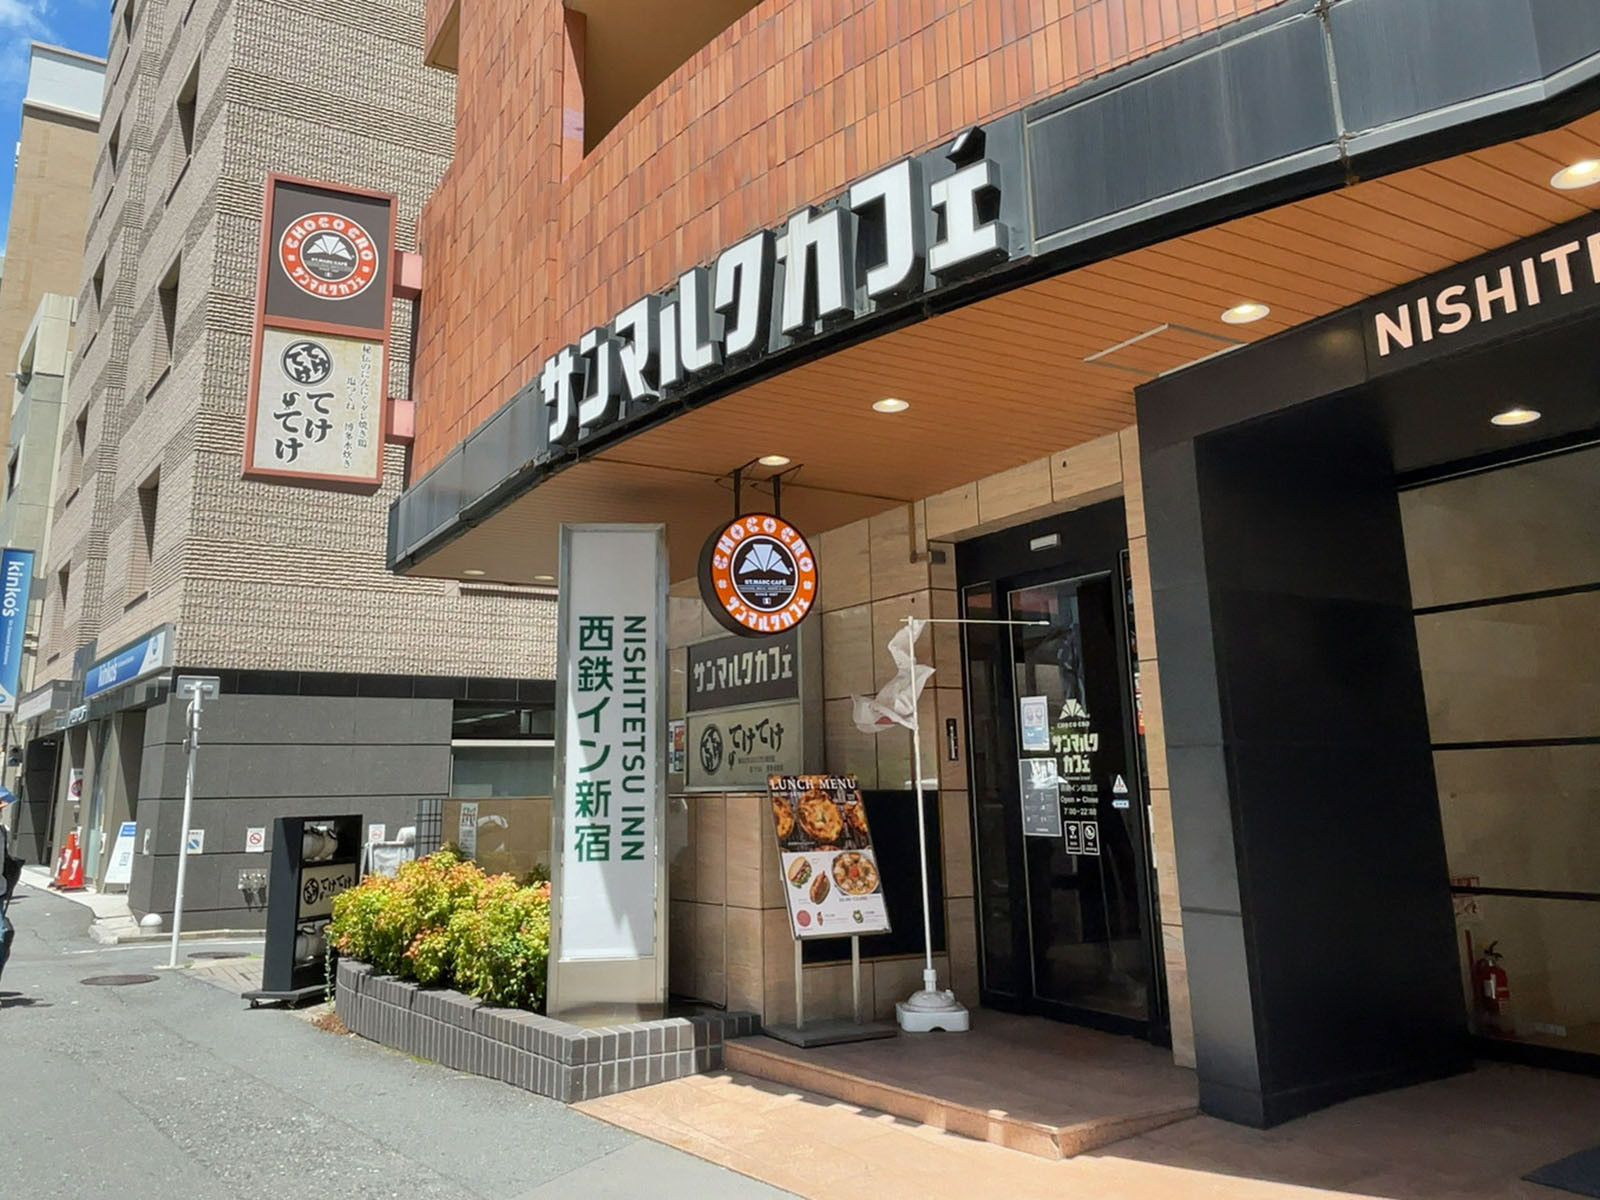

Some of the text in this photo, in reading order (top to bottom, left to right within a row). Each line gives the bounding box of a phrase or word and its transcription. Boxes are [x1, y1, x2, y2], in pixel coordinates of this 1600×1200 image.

[285, 216, 374, 261] CHOCO CRO
[292, 266, 367, 296] サンマルクカフェ
[541, 127, 1006, 444] サンマルクカフェ
[713, 517, 814, 573] CHOCO CRO
[2, 561, 25, 617] kinko's
[726, 596, 810, 632] サンマルクカフェ
[693, 644, 793, 693] サンマルクカフェ
[574, 616, 614, 862] 西鉄イン新宿
[621, 616, 647, 861] NISHITETSU INN
[729, 718, 784, 755] てけてけ
[770, 777, 856, 791] LUNCH MENU
[1062, 754, 1091, 774] カフェ
